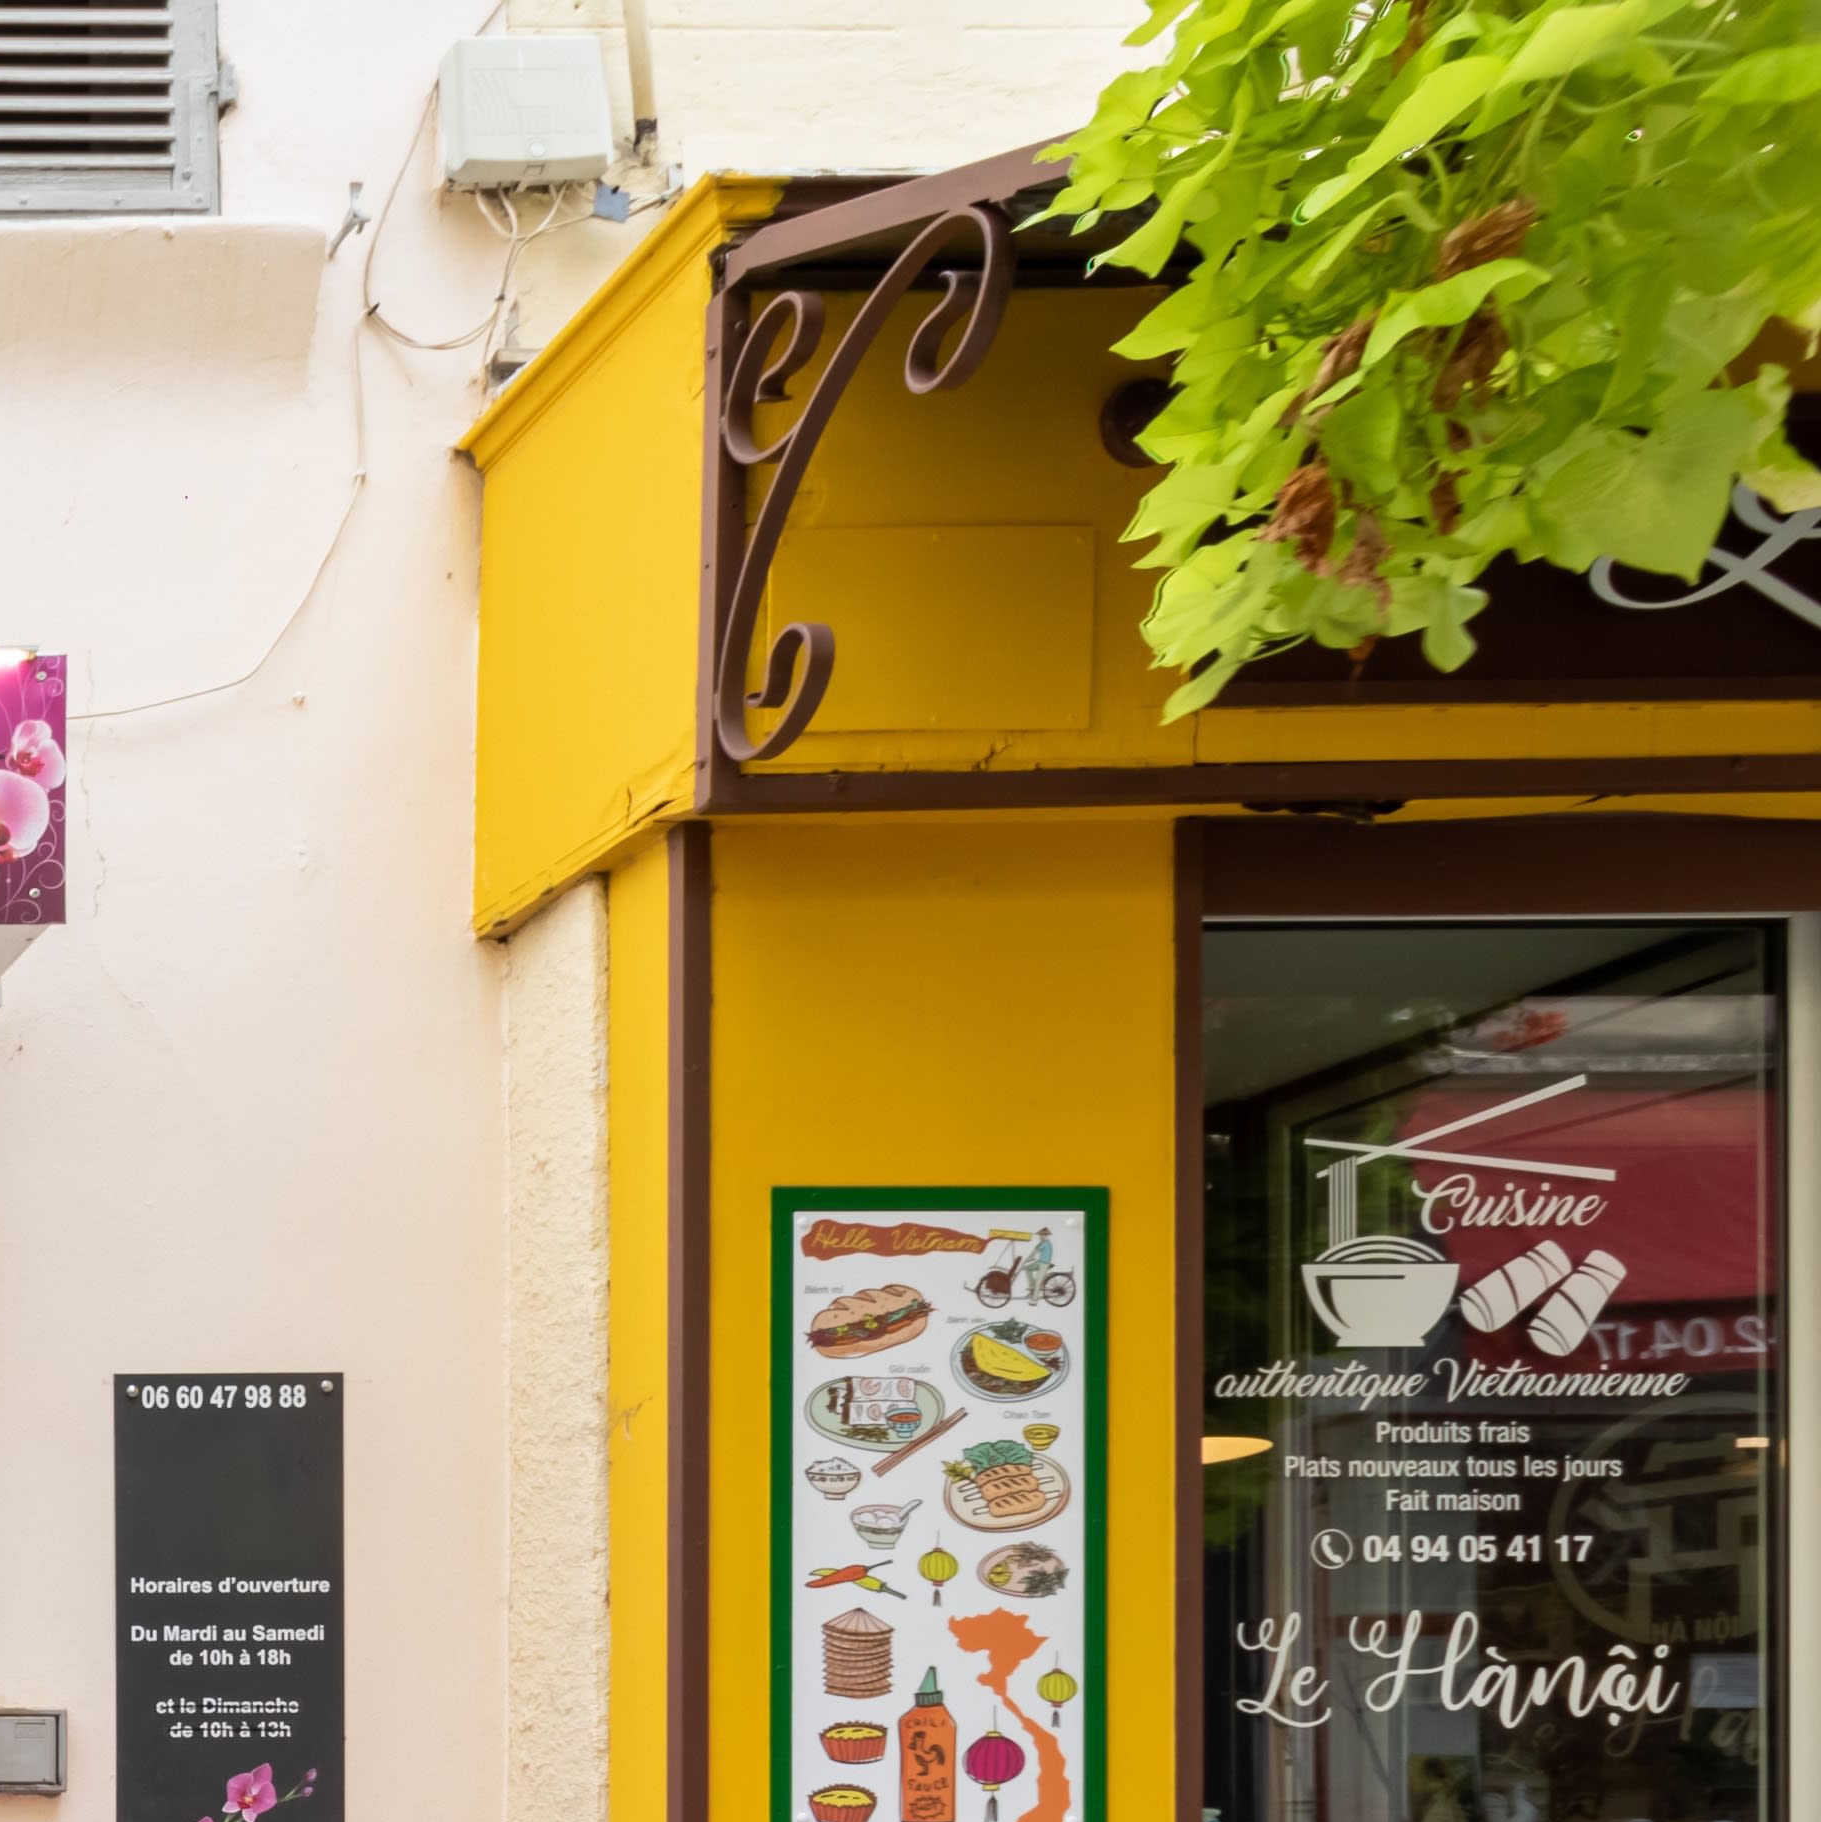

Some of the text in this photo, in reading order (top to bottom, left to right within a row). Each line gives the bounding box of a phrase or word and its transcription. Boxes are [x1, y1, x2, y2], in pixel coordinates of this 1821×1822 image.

[1412, 1173, 1608, 1235] Cuisine
[811, 1223, 982, 1253] Hello Vietnam
[1214, 1357, 1691, 1411] authentique Vietnamienne
[142, 1384, 307, 1408] 06 60 47 98 88
[1376, 1421, 1531, 1443] Produits frais
[1285, 1455, 1623, 1482] Plats nouveaux tous les jours
[1386, 1489, 1521, 1511] Fait maison
[1363, 1535, 1593, 1563] 04 94 05 41 17
[131, 1575, 330, 1595] Horaires d'ouverture
[131, 1624, 325, 1643] Du Mardi au Samedi
[170, 1648, 291, 1667] de 10h à 18h
[1237, 1612, 1332, 1728] Le
[203, 1697, 299, 1715] Dimanche
[170, 1721, 193, 1739] de
[239, 1721, 251, 1739] à
